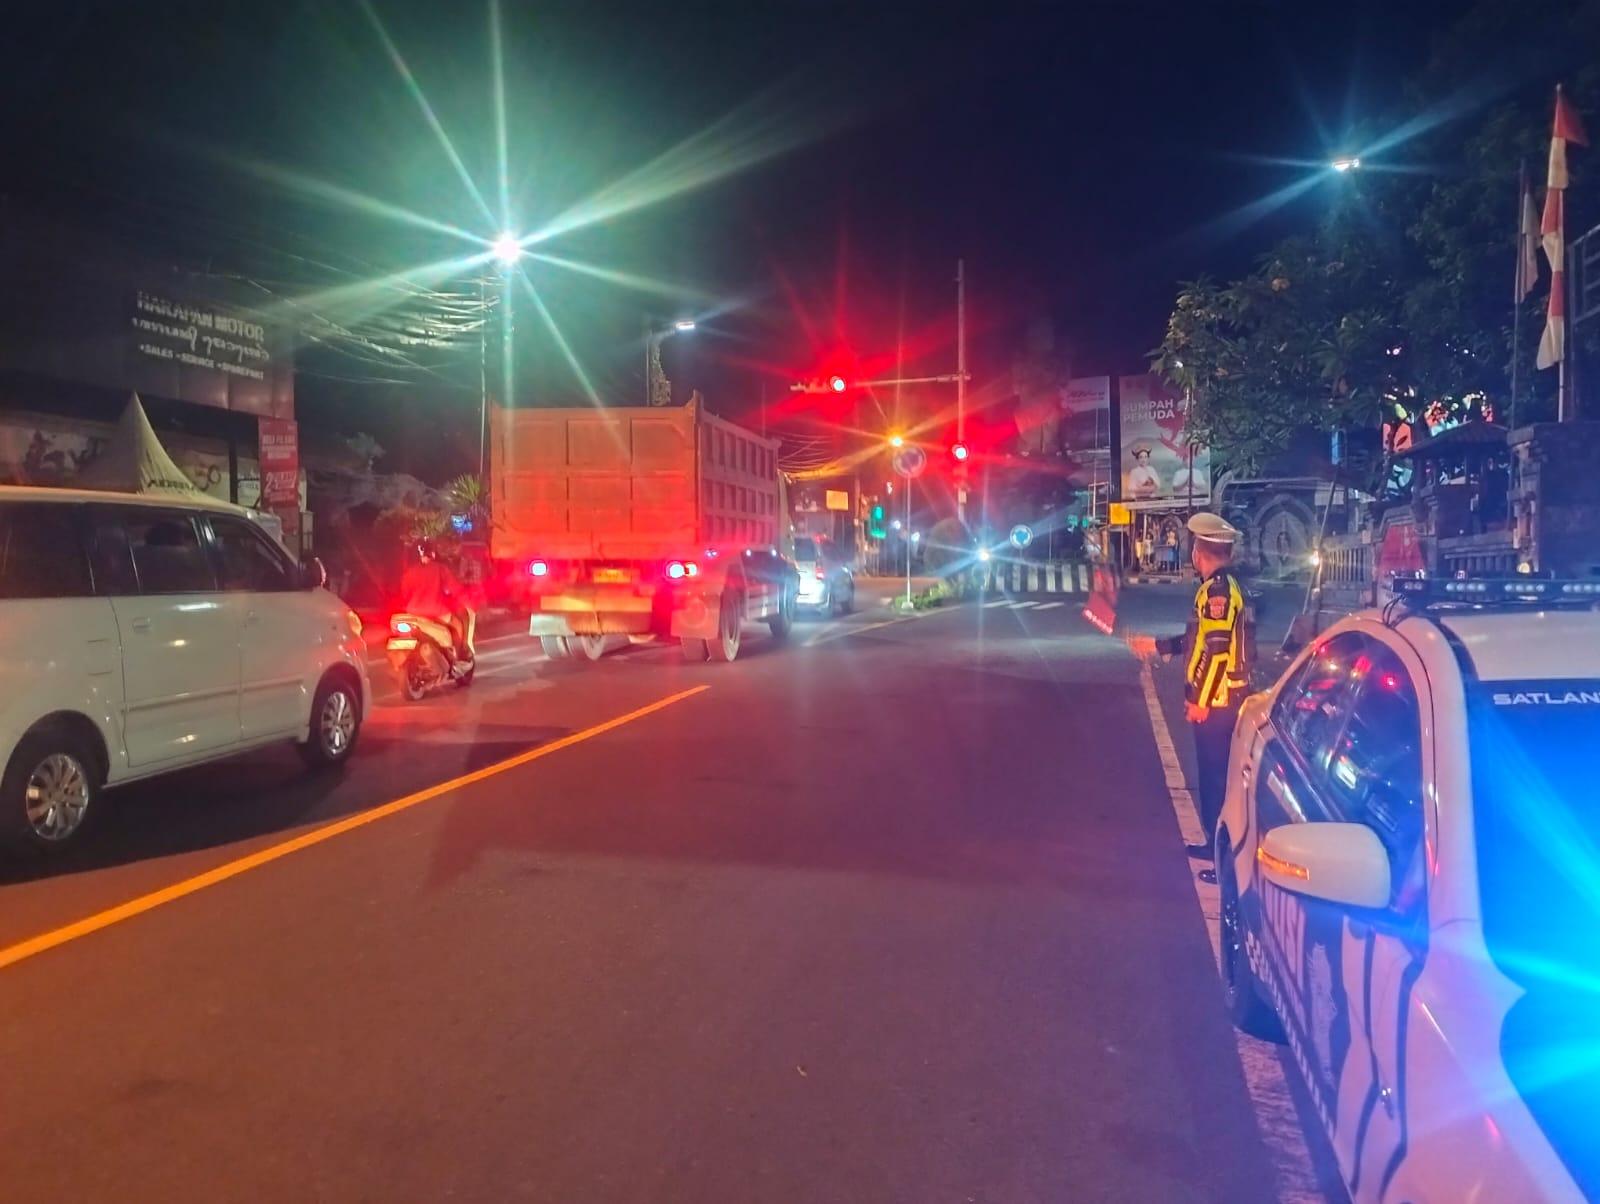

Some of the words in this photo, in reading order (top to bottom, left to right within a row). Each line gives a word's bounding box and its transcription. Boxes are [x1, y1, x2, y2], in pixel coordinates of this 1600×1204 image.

[214, 314, 264, 343] MOTOR
[1124, 399, 1174, 414] SUMPAH
[1123, 409, 1176, 425] PEMUDA
[1493, 692, 1600, 706] SATLAN
